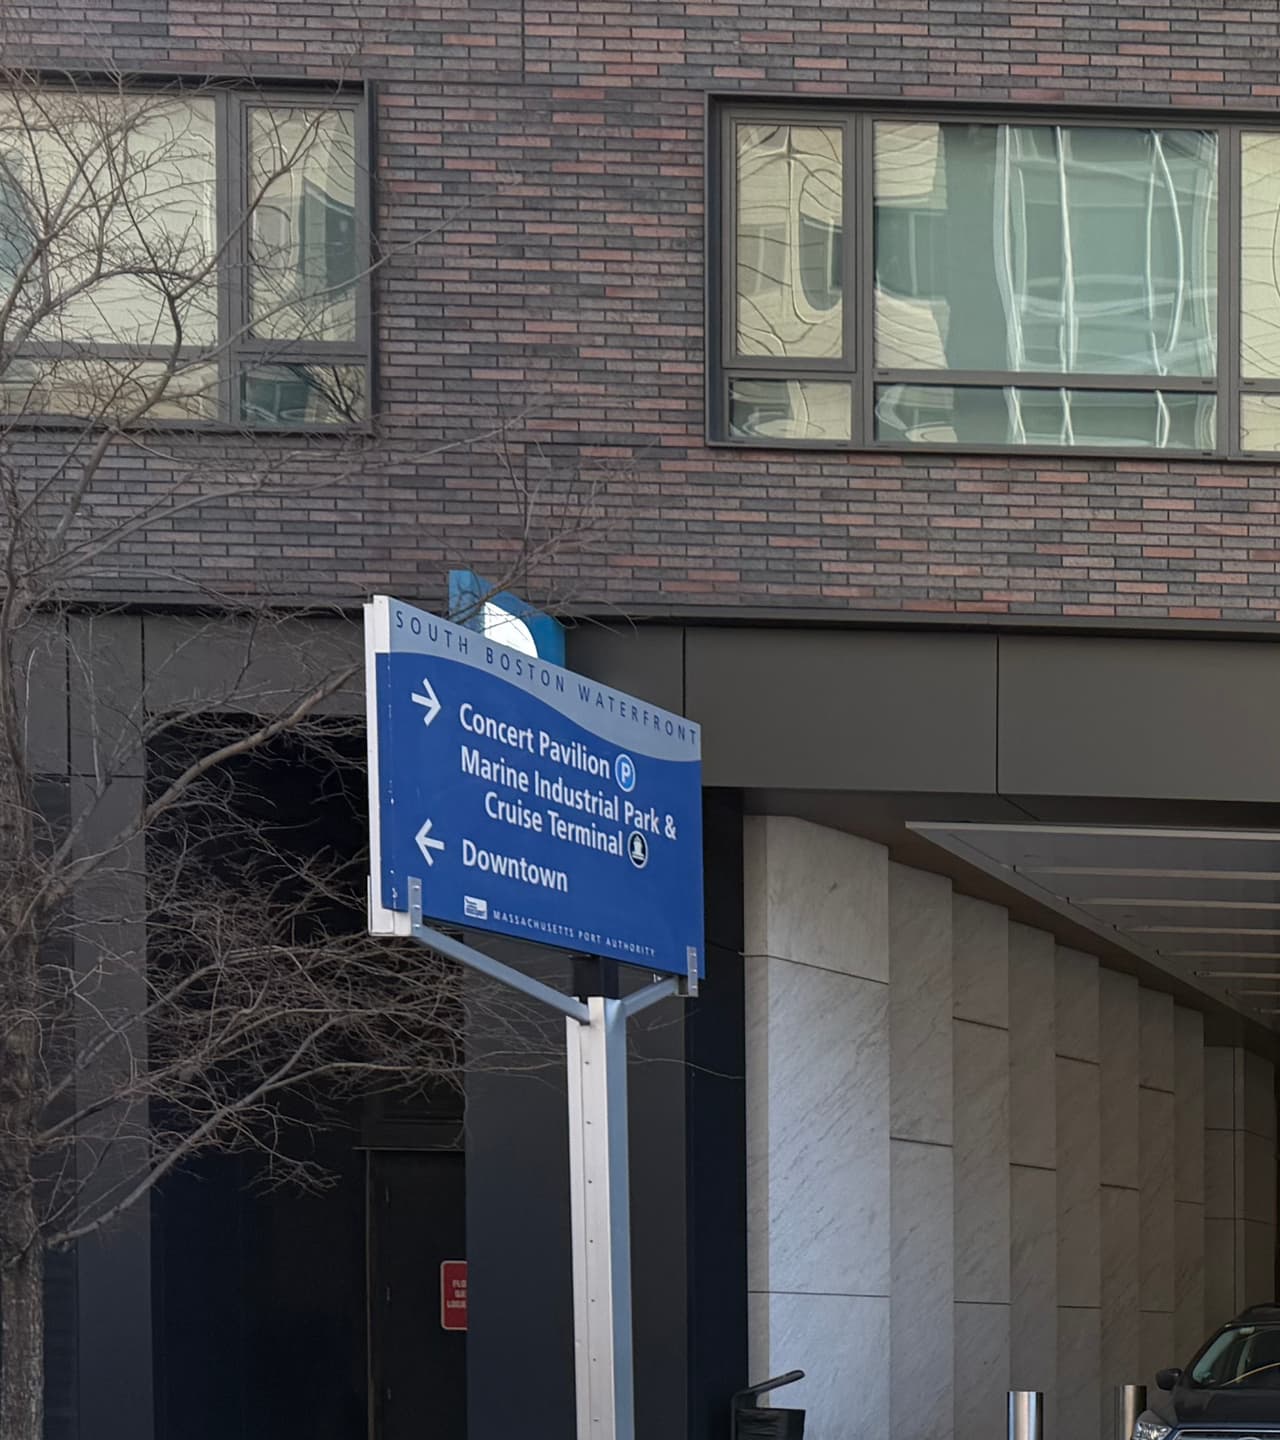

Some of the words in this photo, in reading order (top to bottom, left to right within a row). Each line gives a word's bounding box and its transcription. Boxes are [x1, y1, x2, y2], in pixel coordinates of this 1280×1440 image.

[395, 609, 469, 656] SOUTH
[485, 645, 565, 693] BOSTON
[578, 683, 698, 746] WATERFRONT
[459, 702, 534, 754] Concert
[539, 730, 611, 780] Pavilion
[461, 744, 530, 793] Marine
[534, 770, 620, 822] Industrial
[624, 800, 660, 836] Park
[664, 814, 678, 841] &
[484, 791, 543, 833] Cruise
[547, 809, 624, 857] Terminal
[462, 838, 569, 893] Downtown
[492, 909, 575, 939] MASSACHUSETTS
[578, 930, 602, 944] PORT
[605, 937, 656, 957] AUTHORITY
